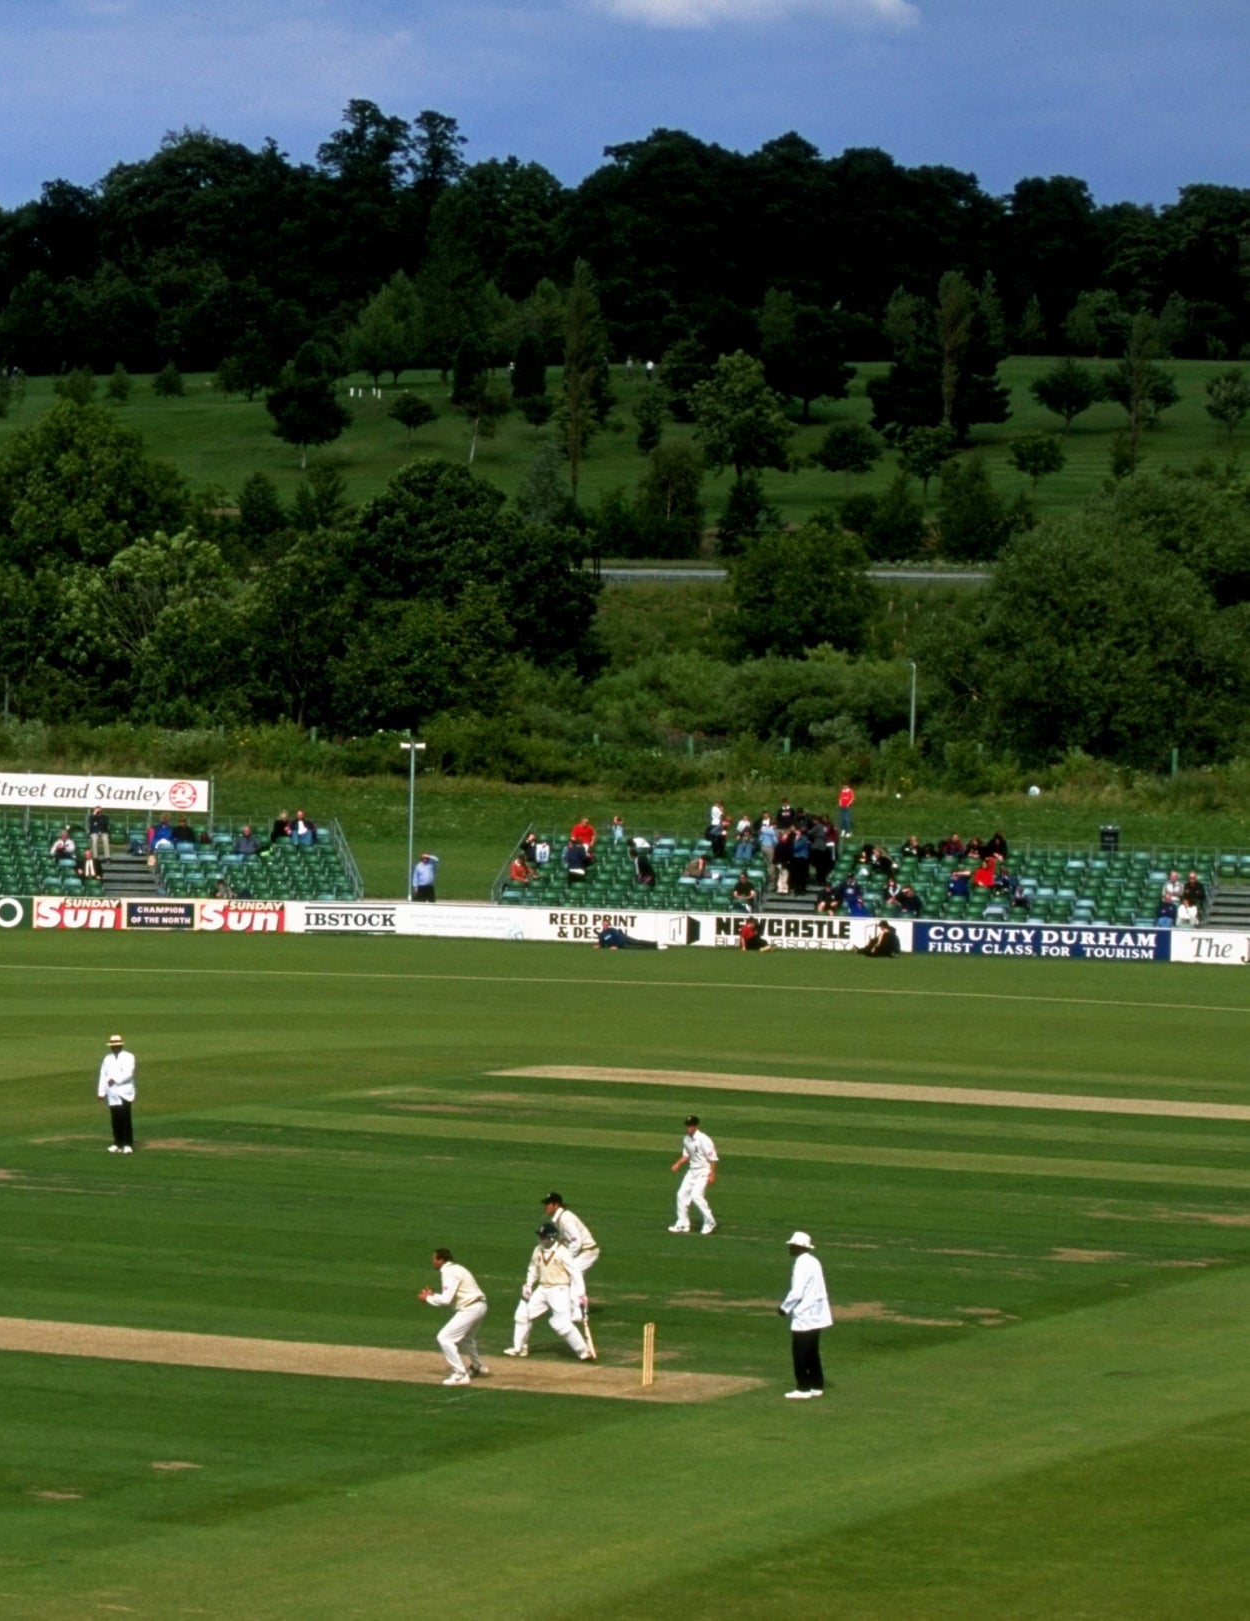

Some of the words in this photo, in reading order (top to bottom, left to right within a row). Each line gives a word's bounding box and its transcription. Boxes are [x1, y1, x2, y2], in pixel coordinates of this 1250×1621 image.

[53, 783, 89, 799] and
[95, 783, 166, 806] Stanley
[64, 898, 121, 908] SUNDAY
[229, 901, 284, 911] SUNDAY
[37, 901, 116, 929] Sun
[137, 906, 185, 915] CHAMPION
[201, 902, 278, 931] Sun
[131, 916, 141, 924] OF
[144, 916, 160, 924] THE
[162, 917, 191, 925] NORTH
[305, 913, 396, 927] IBSTOCK
[549, 913, 588, 926] REED
[593, 914, 637, 927] PRINT
[557, 926, 568, 938] &
[573, 926, 628, 940] DESN
[716, 916, 850, 939] NEWCASTLE
[928, 926, 1035, 943] COUNTY
[1041, 930, 1157, 947] DURHAM
[786, 938, 850, 951] SOCIETY
[928, 942, 972, 953] FIRST
[981, 943, 1033, 955] CLASS
[1041, 946, 1070, 957] FOR
[1083, 946, 1154, 960] TOURISM
[1191, 937, 1233, 958] The
